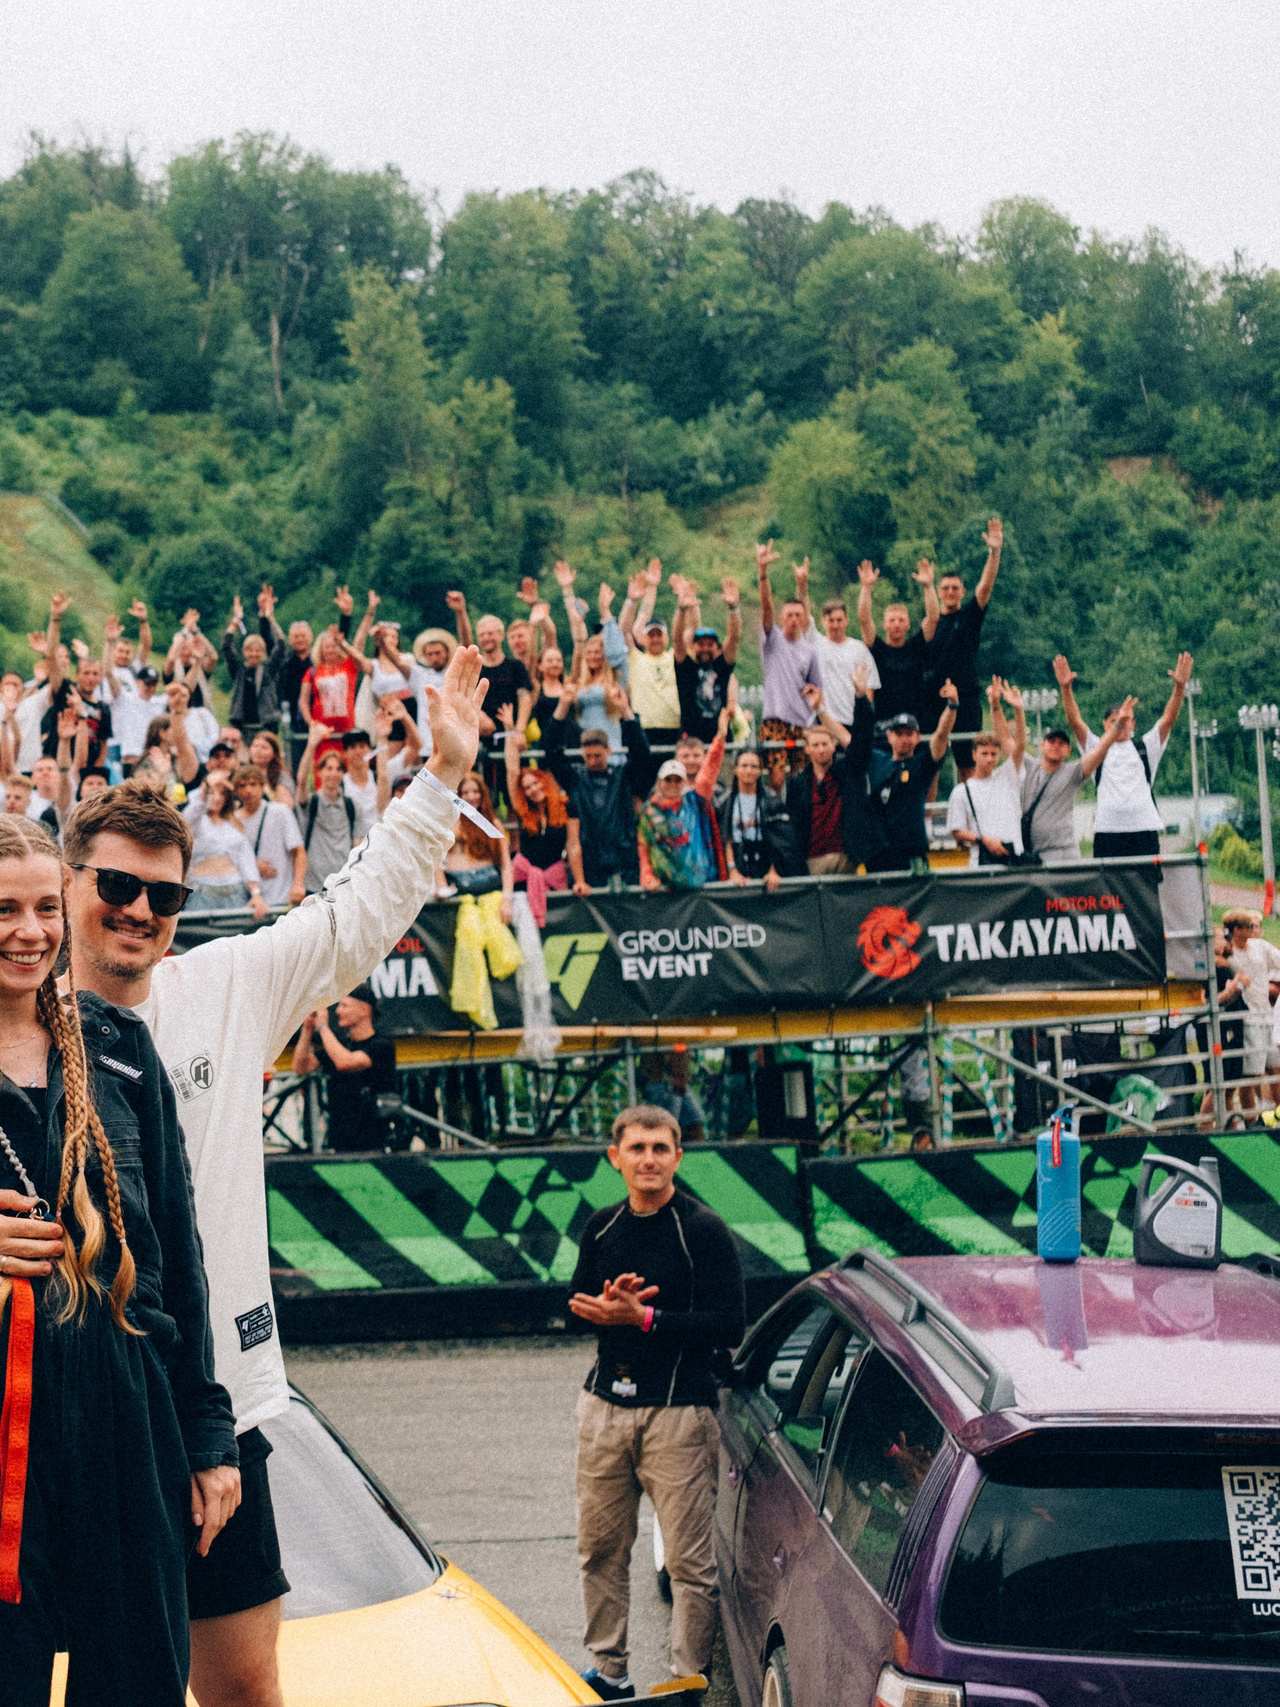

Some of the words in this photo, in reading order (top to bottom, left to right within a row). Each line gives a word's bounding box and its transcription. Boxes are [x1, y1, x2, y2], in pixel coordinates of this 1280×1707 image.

[1046, 896, 1098, 913] MOTOR
[1099, 894, 1125, 911] OIL
[617, 923, 767, 956] GROUNDED
[927, 913, 1138, 963] TAKAYAMA
[621, 952, 713, 981] EVENT
